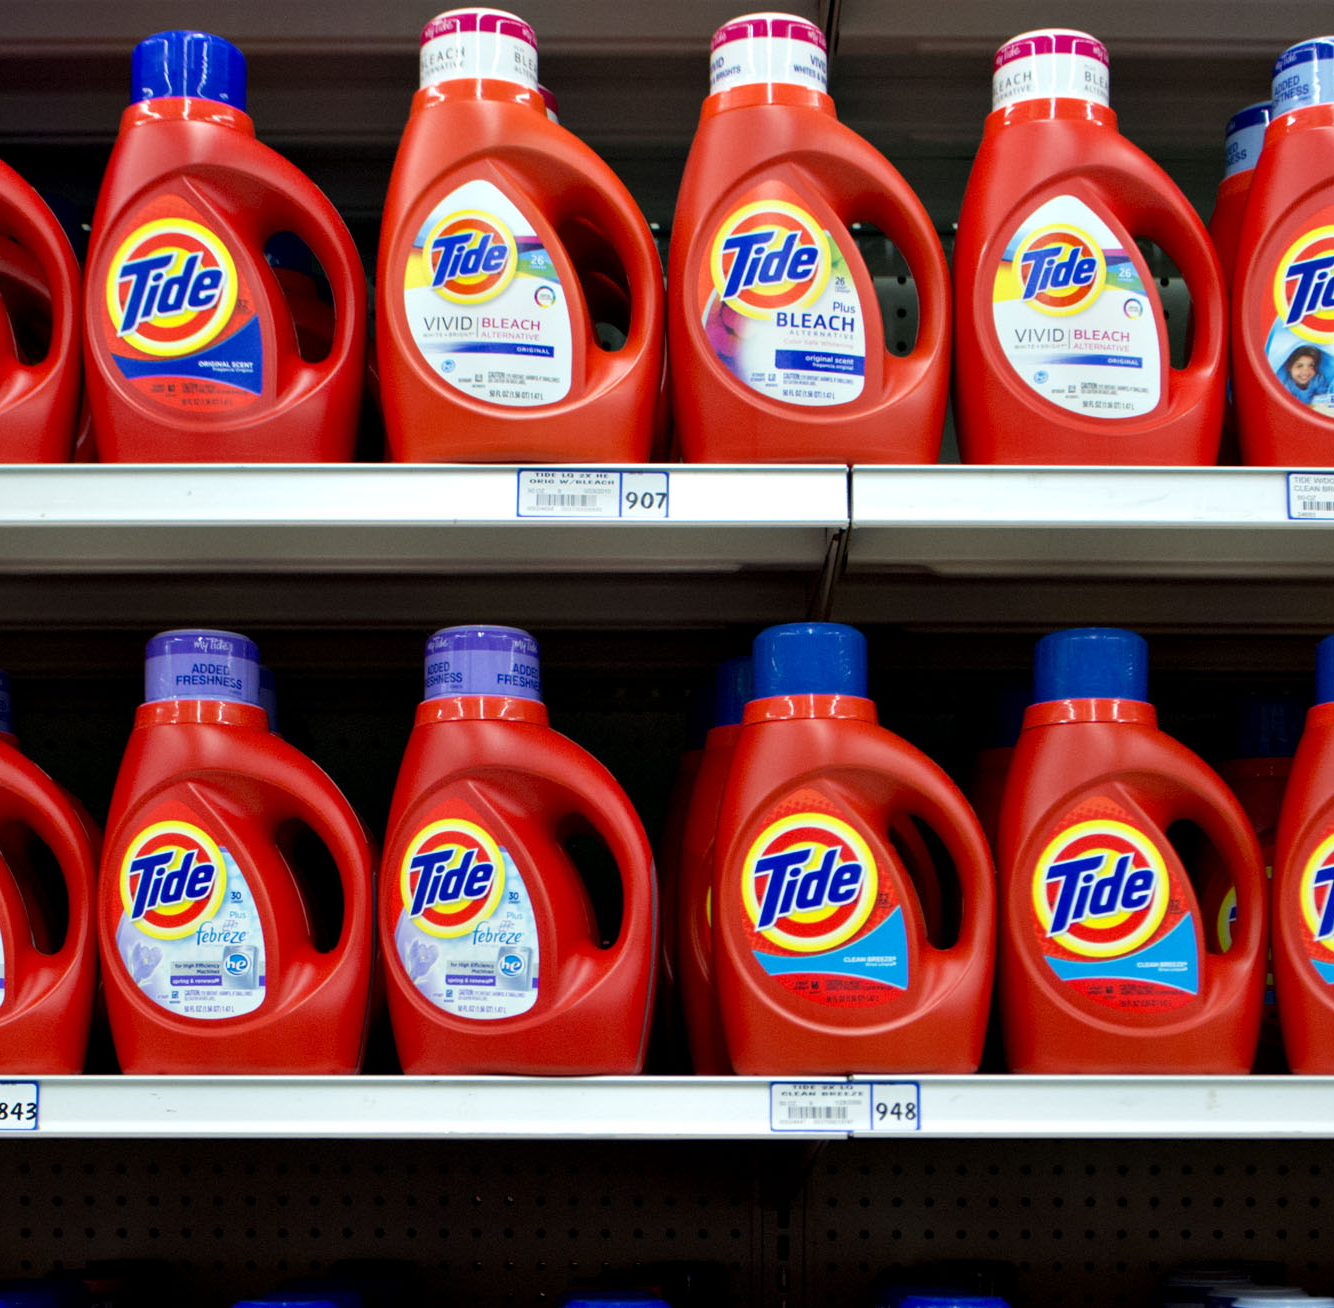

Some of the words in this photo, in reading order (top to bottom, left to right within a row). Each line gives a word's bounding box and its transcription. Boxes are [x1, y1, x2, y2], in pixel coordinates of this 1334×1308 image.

[432, 231, 508, 289] Tide
[722, 230, 817, 301] Tide
[1021, 246, 1097, 301] Tide
[117, 251, 224, 337] Tide
[832, 302, 856, 314] Plus
[424, 316, 472, 332] VIVID
[481, 318, 541, 331] BLEACH
[776, 312, 855, 331] BLEACH
[1015, 329, 1064, 344] VIVID
[1074, 330, 1130, 343] BLEACH
[625, 491, 667, 511] 907
[191, 663, 231, 675] ADDED
[175, 674, 243, 690] FRESHNESS
[130, 851, 215, 920] Tide
[409, 849, 495, 918] Tide
[754, 846, 865, 931] Tide
[1045, 853, 1157, 937] Tide
[196, 925, 247, 947] febreze
[472, 922, 522, 944] febreze
[875, 1102, 917, 1121] 948
